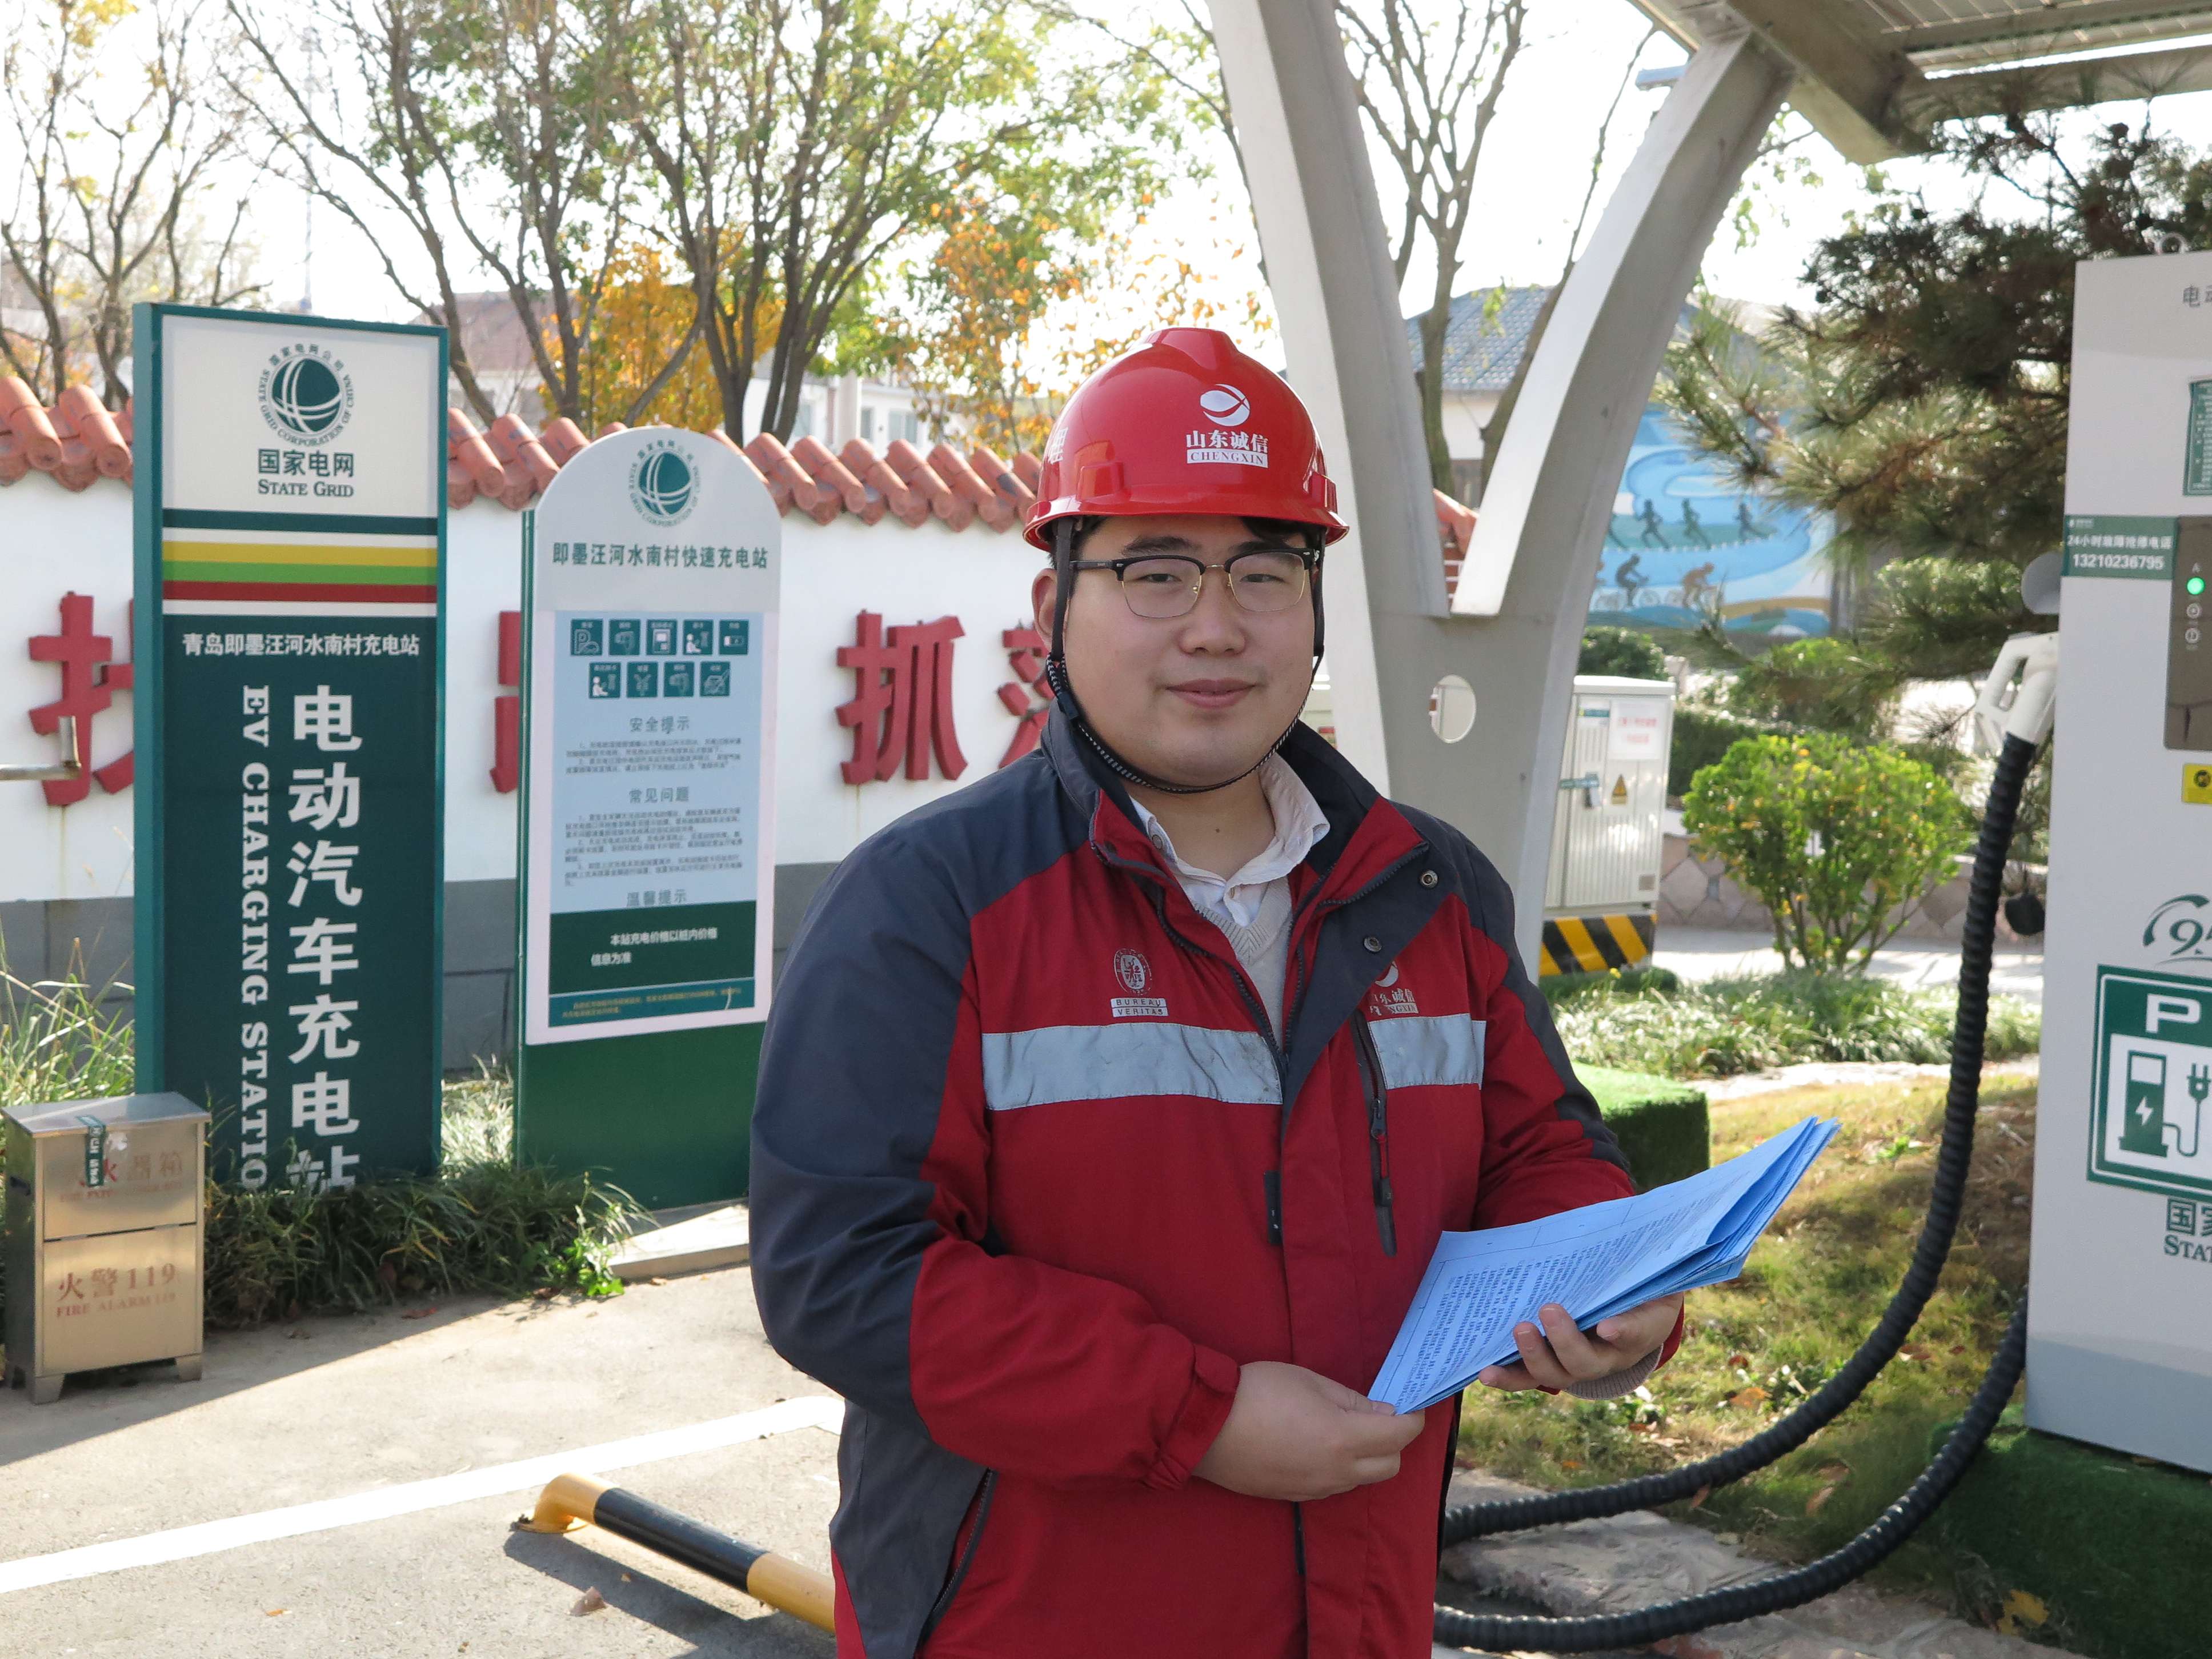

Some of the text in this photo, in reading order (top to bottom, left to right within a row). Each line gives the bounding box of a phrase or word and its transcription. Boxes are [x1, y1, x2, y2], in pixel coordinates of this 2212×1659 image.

[1186, 430, 1268, 453] 山东诚信
[258, 448, 354, 478] 国家电网
[1191, 451, 1264, 465] CHENGXIN
[258, 478, 354, 498] STATE GRID
[552, 542, 768, 569] 即墨汪河水南村快速充电站
[182, 632, 420, 656] 青岛即墨汪河水南村充电站
[243, 685, 269, 747] EV
[630, 716, 690, 734] 安全提示
[629, 787, 689, 803] 常见问题
[242, 762, 269, 1005] CHARGING
[286, 684, 363, 1195] 电动汽车充电站
[2146, 993, 2201, 1033] P
